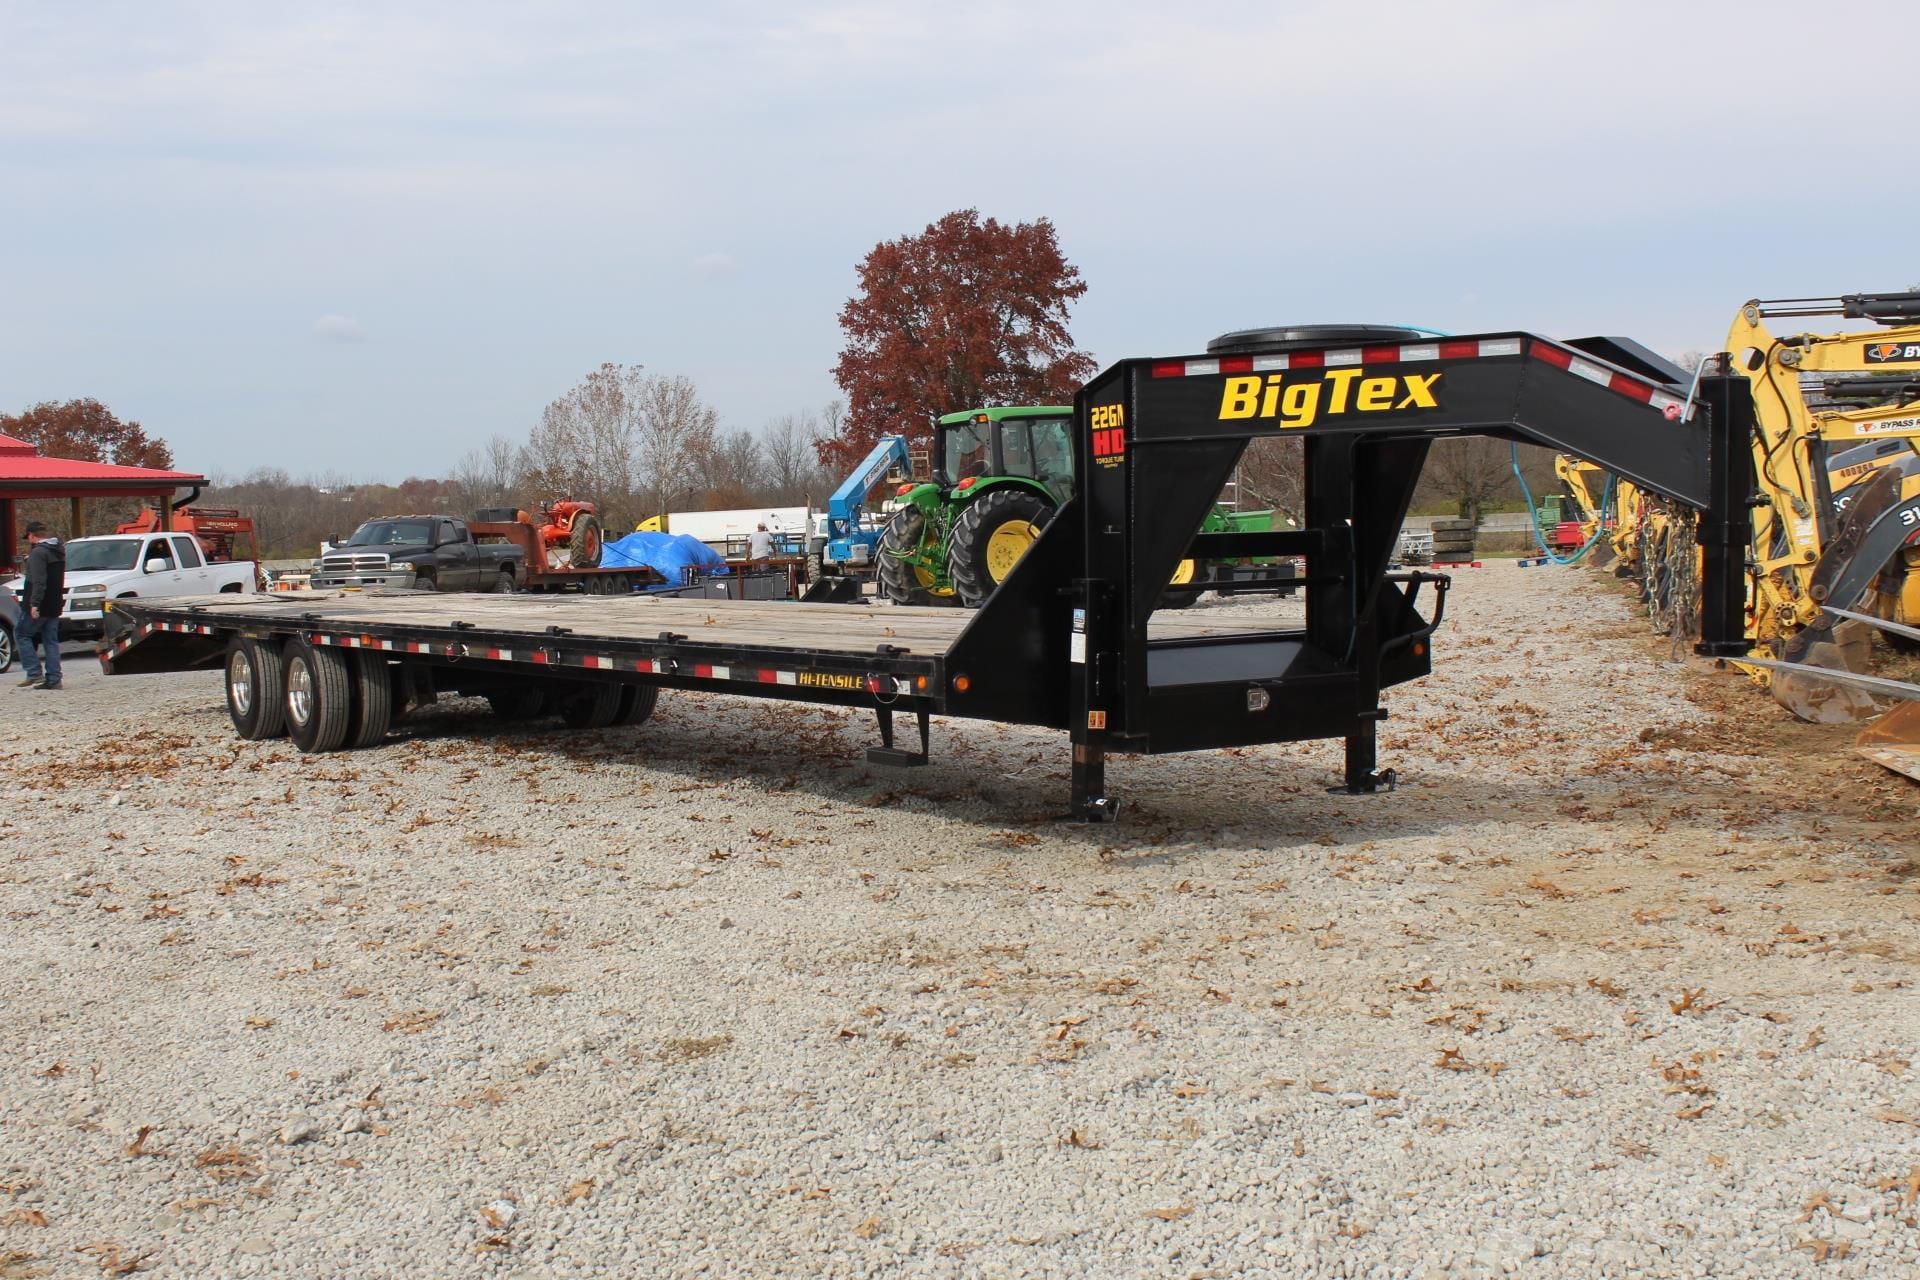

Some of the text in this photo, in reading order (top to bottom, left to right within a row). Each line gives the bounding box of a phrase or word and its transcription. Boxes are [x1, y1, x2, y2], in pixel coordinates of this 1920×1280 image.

[1880, 419, 1914, 429] BYPASS
[1093, 428, 1125, 456] HD
[800, 672, 863, 689] HI-TENSILE
